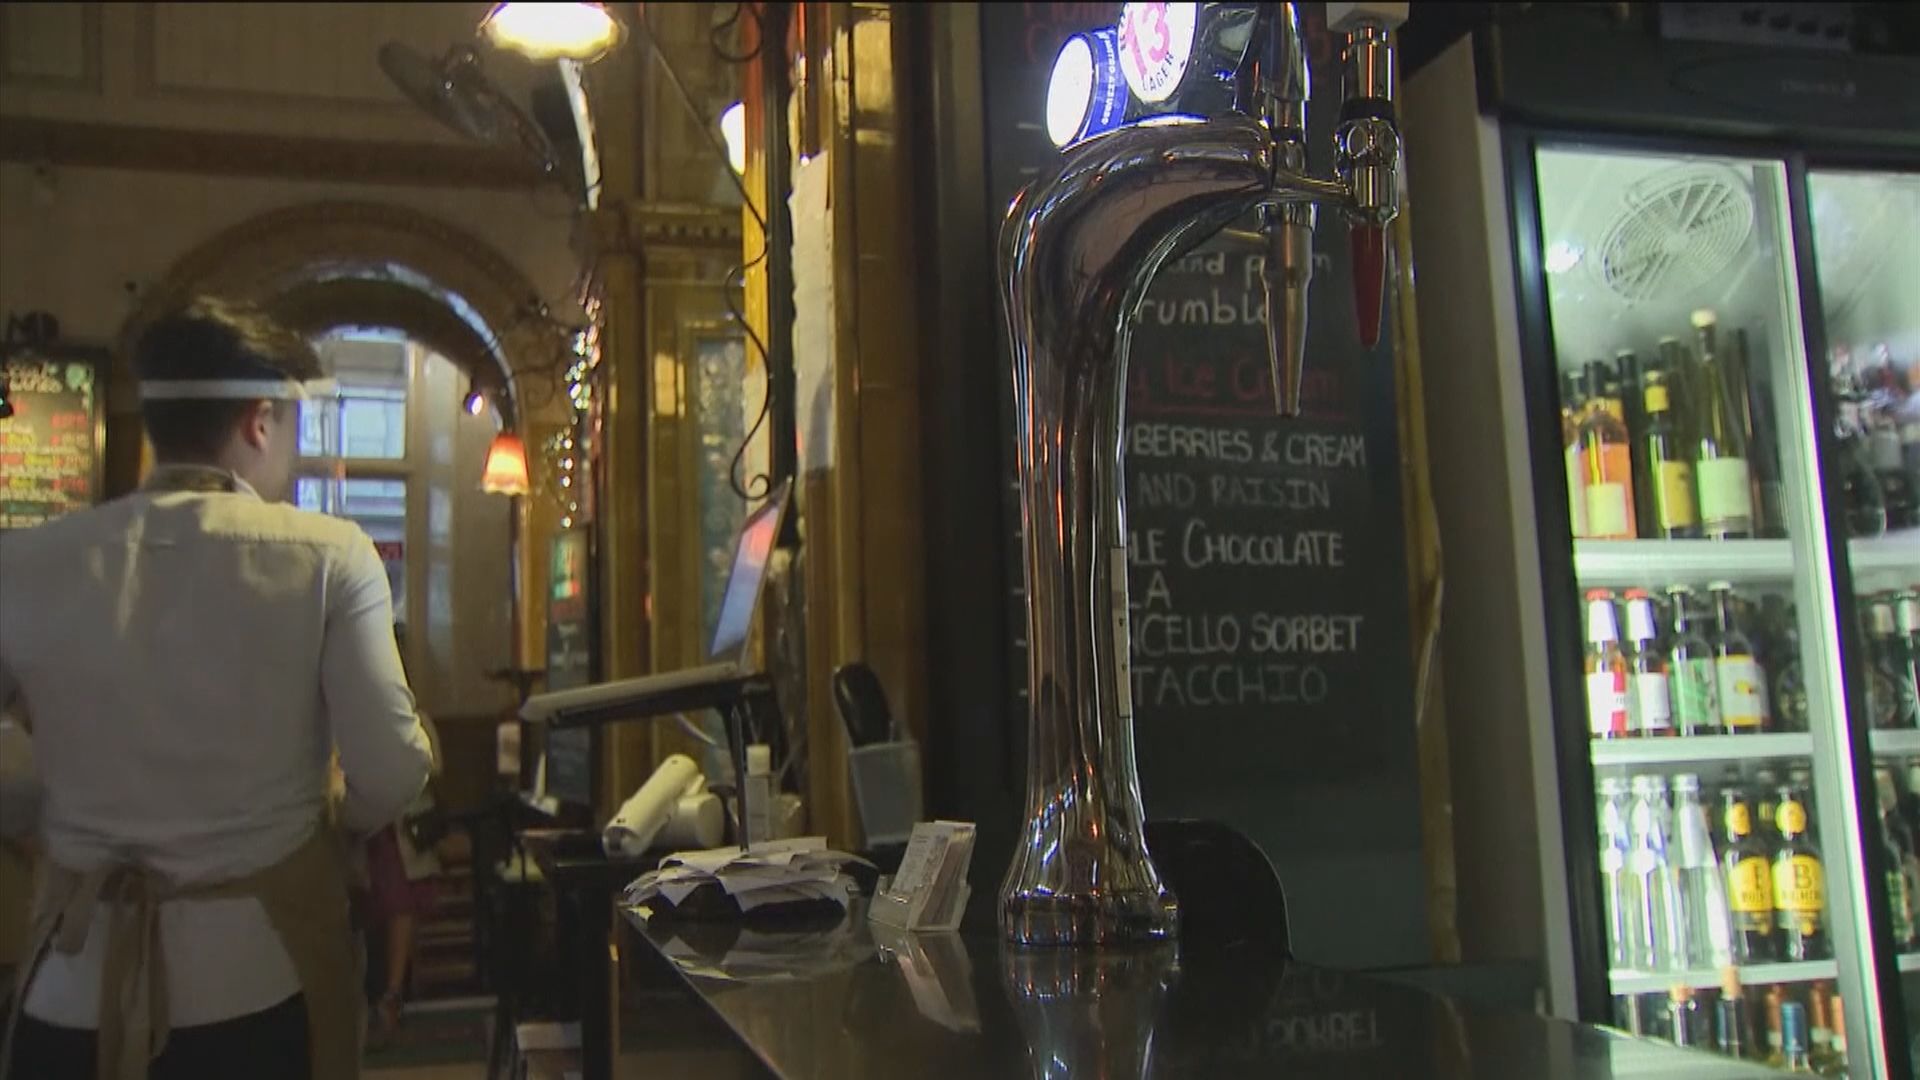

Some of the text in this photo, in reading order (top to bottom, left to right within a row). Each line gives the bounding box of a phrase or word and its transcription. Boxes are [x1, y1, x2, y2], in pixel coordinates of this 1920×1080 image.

[1141, 50, 1175, 92] LAGER
[1127, 422, 1253, 464] BERRIES
[1285, 434, 1366, 468] CREAM
[1137, 472, 1331, 509] AND RAISIN
[1251, 612, 1364, 654] SORBET
[1131, 664, 1330, 707] TACCHIO
